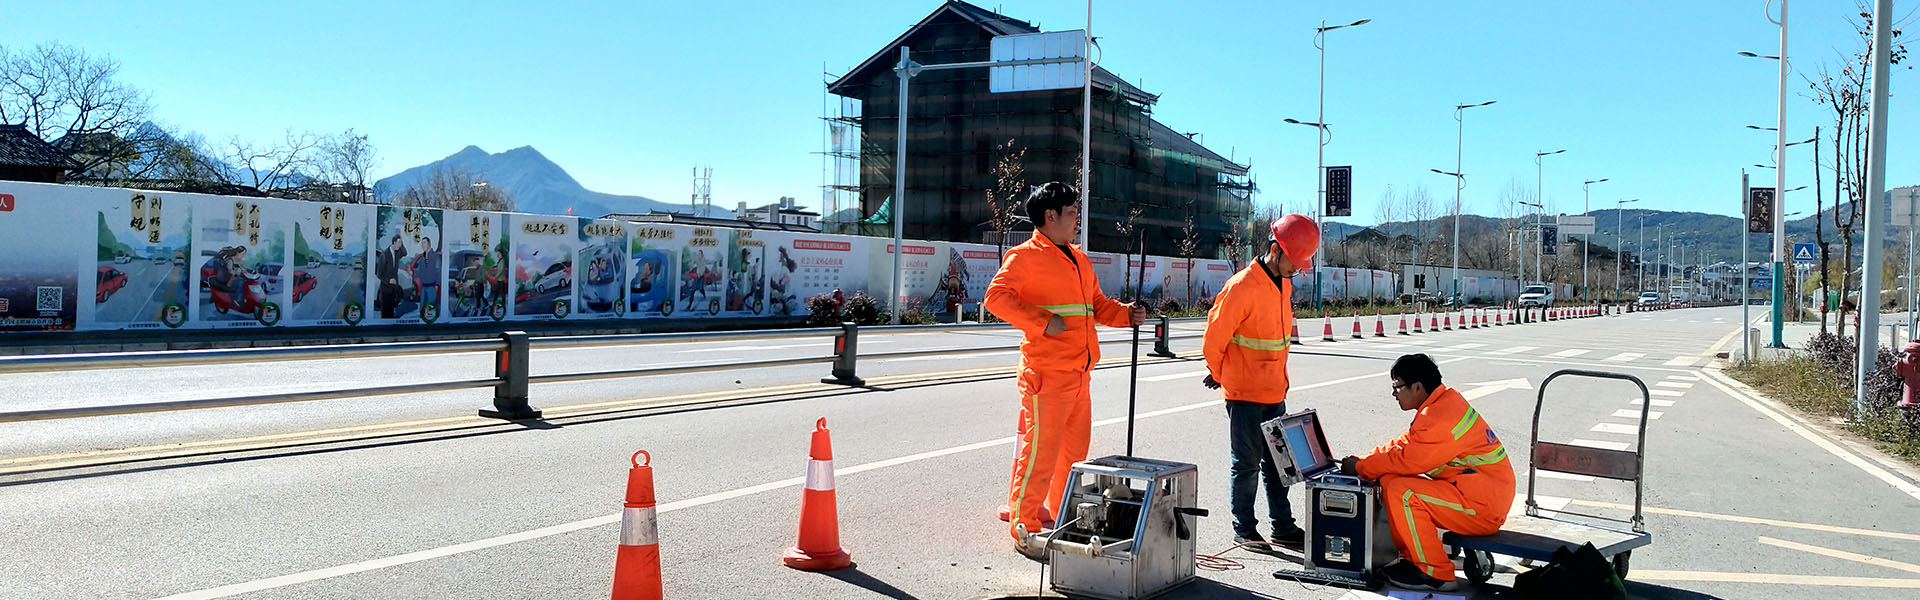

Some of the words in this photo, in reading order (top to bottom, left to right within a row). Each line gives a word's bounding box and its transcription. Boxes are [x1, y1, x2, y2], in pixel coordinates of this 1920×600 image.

[525, 223, 566, 235] 超速不安全
